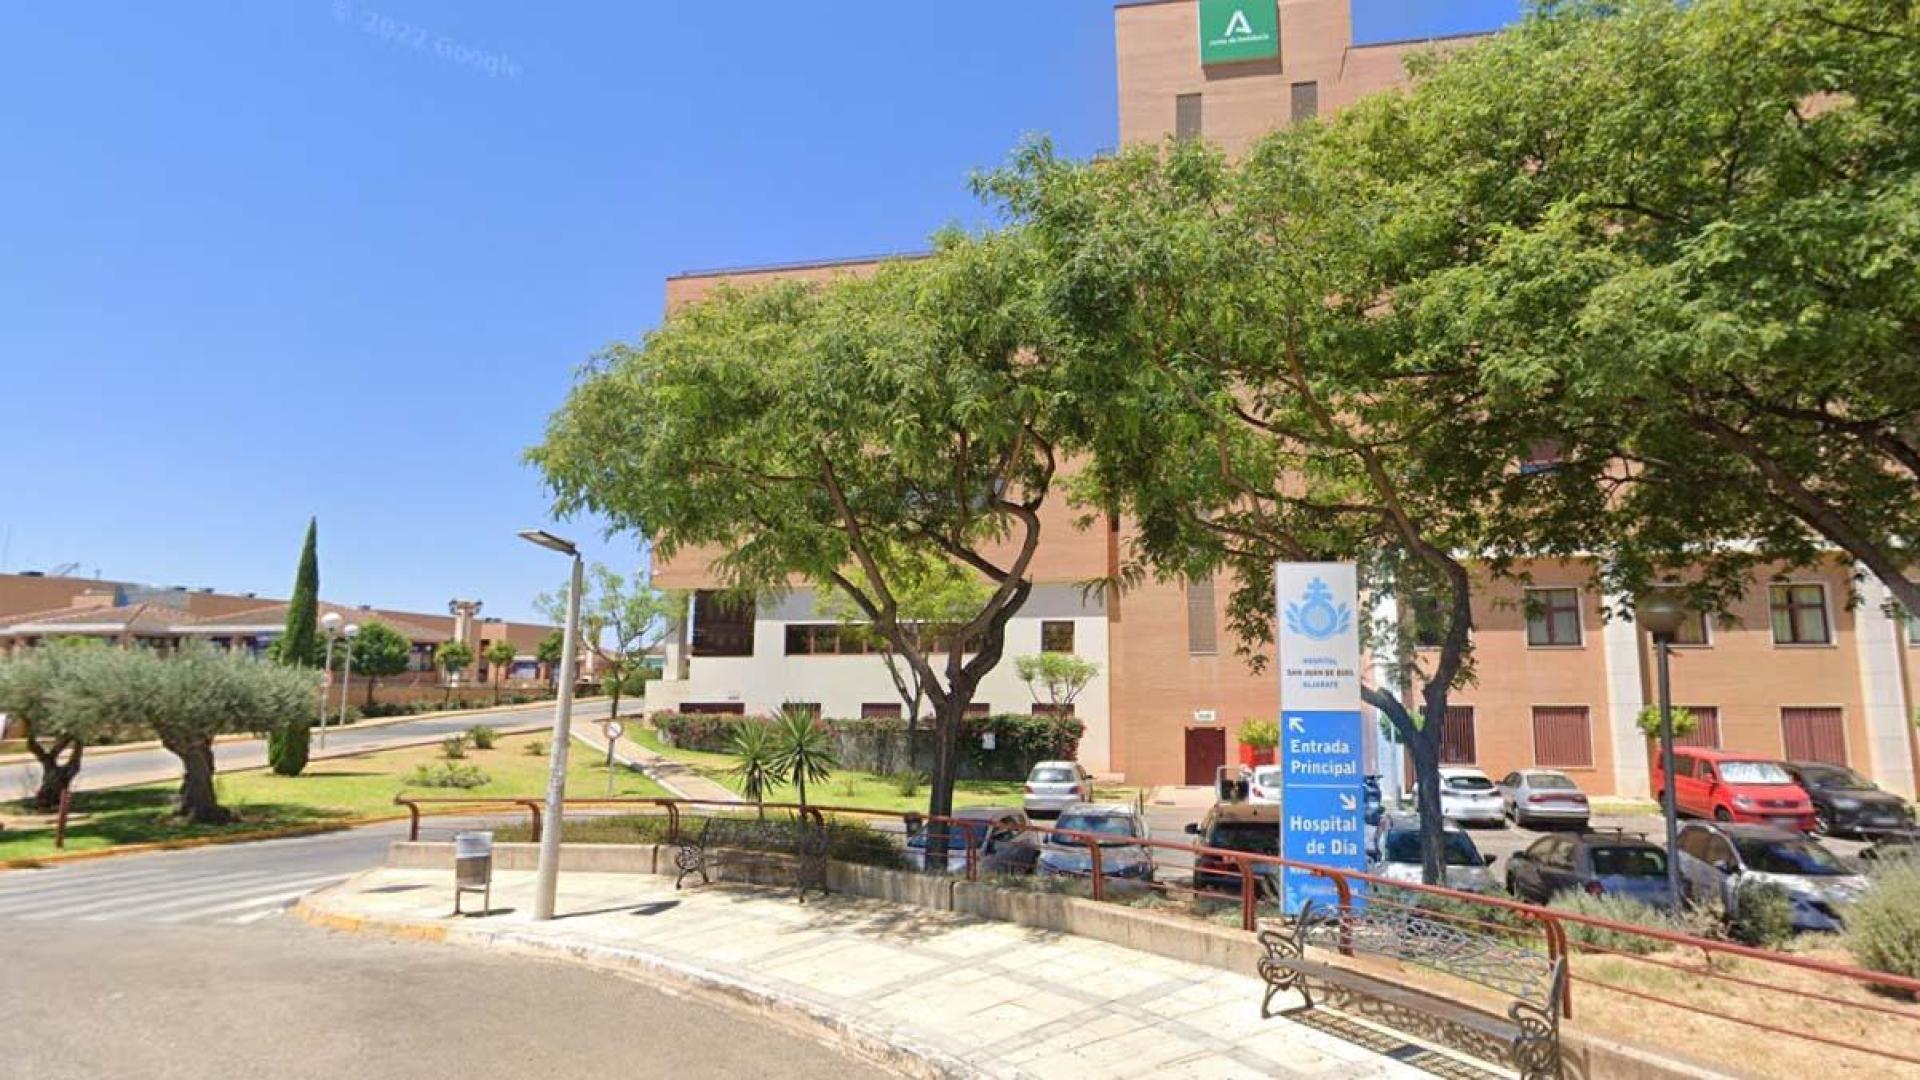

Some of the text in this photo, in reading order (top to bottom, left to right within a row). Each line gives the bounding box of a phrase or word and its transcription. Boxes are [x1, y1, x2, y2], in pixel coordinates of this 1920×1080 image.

[1287, 668, 1302, 676] SAN
[1304, 668, 1323, 676] JUAN
[1290, 740, 1350, 754] Entrada
[1291, 760, 1356, 776] Principal
[1290, 816, 1357, 834] Hospital
[1306, 839, 1326, 855] de
